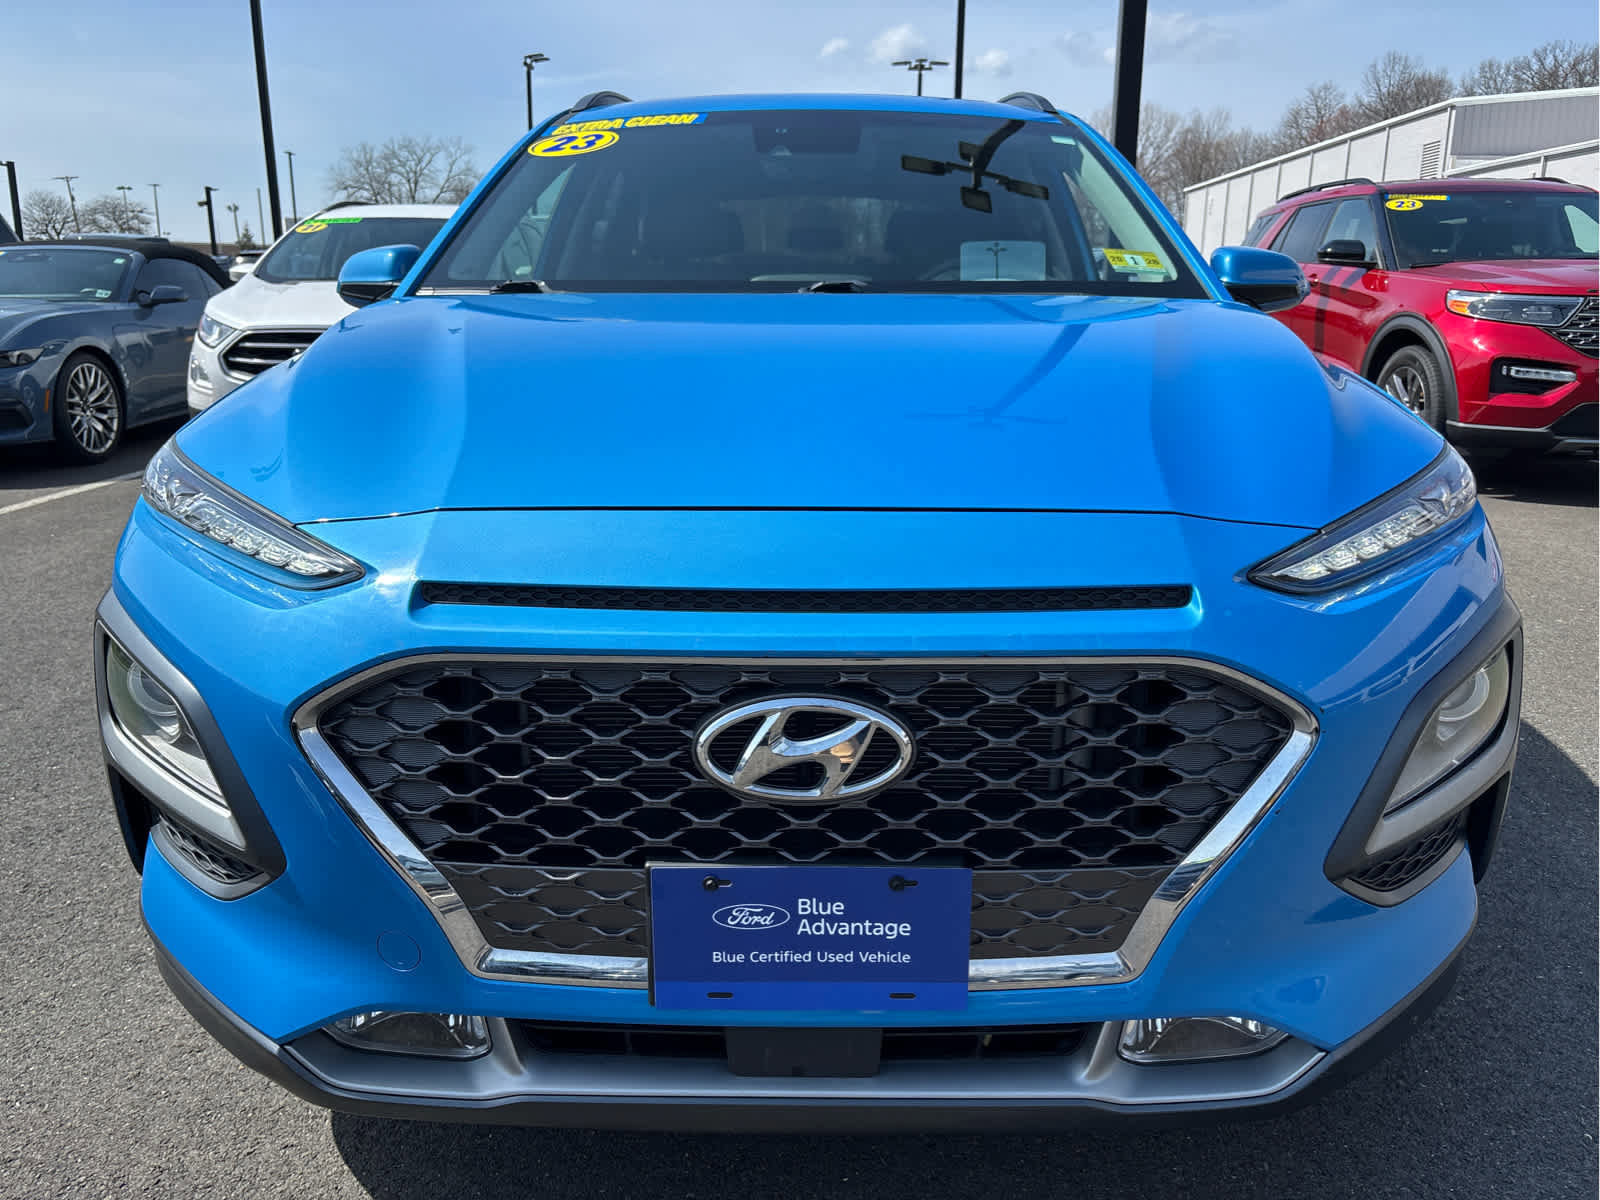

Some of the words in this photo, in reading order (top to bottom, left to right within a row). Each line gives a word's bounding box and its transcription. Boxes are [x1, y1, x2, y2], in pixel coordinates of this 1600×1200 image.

[552, 119, 624, 135] EXTRA
[624, 113, 699, 128] CLEAN
[542, 134, 604, 152] 23
[1395, 200, 1417, 208] 23
[798, 898, 845, 915] Blue
[727, 907, 775, 925] Ford
[797, 918, 911, 939] Advantage
[712, 951, 745, 963] Blue
[750, 950, 812, 963] Certified
[817, 950, 854, 963] Used
[859, 951, 911, 963] Vehicle
